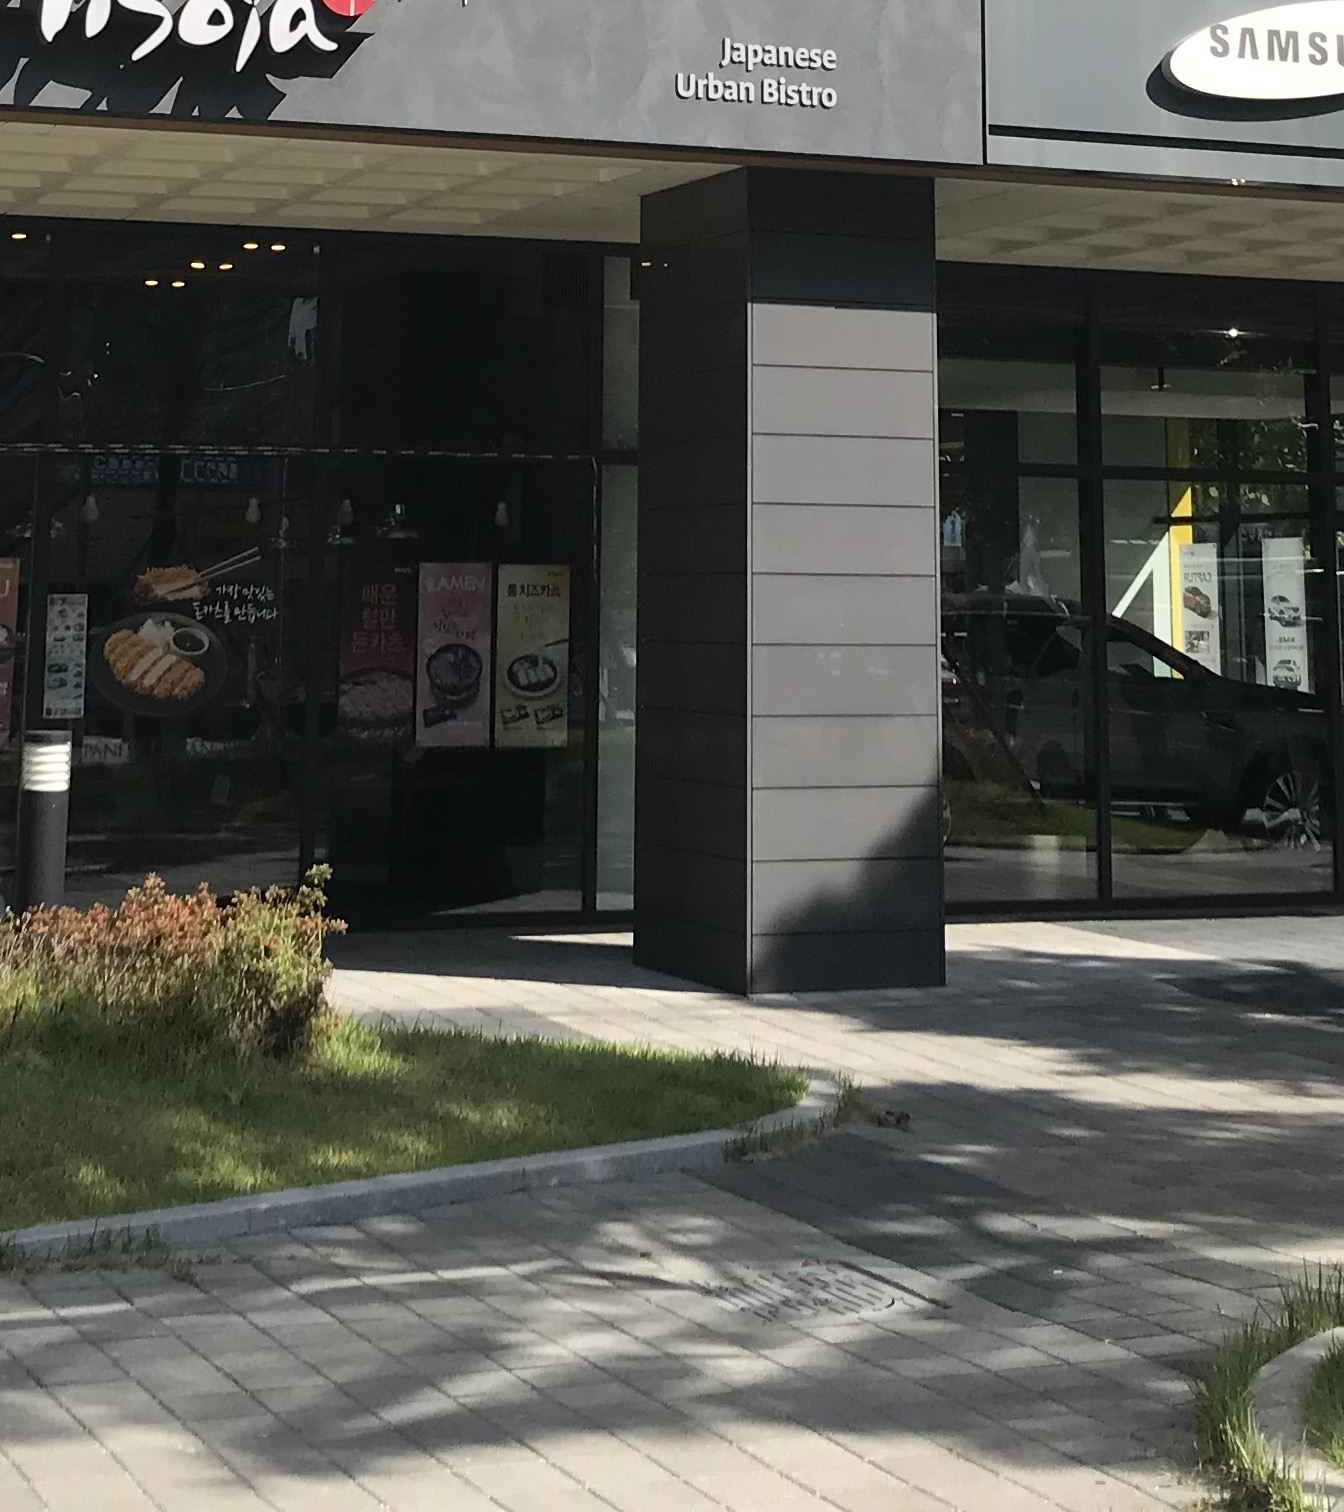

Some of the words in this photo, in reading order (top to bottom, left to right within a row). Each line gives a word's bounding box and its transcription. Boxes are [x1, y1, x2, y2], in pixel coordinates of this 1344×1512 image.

[719, 37, 837, 72] Japanese
[675, 72, 755, 103] Urban
[761, 77, 838, 109] Bistro
